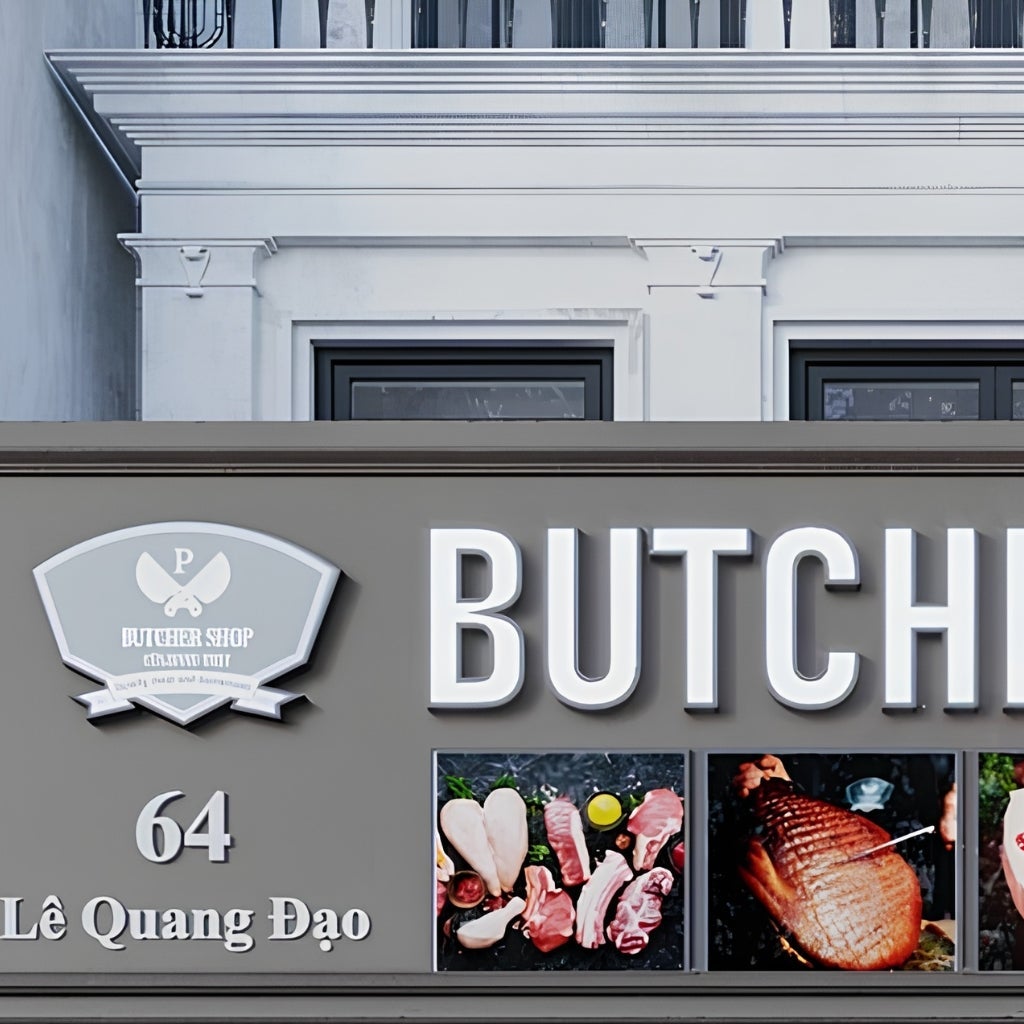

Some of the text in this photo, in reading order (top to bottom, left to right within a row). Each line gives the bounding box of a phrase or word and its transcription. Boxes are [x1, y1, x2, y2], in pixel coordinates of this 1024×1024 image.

[174, 547, 194, 574] P
[205, 627, 255, 648] SHOP
[136, 790, 232, 862] 64
[0, 895, 371, 952] Lê Quang Đạo
